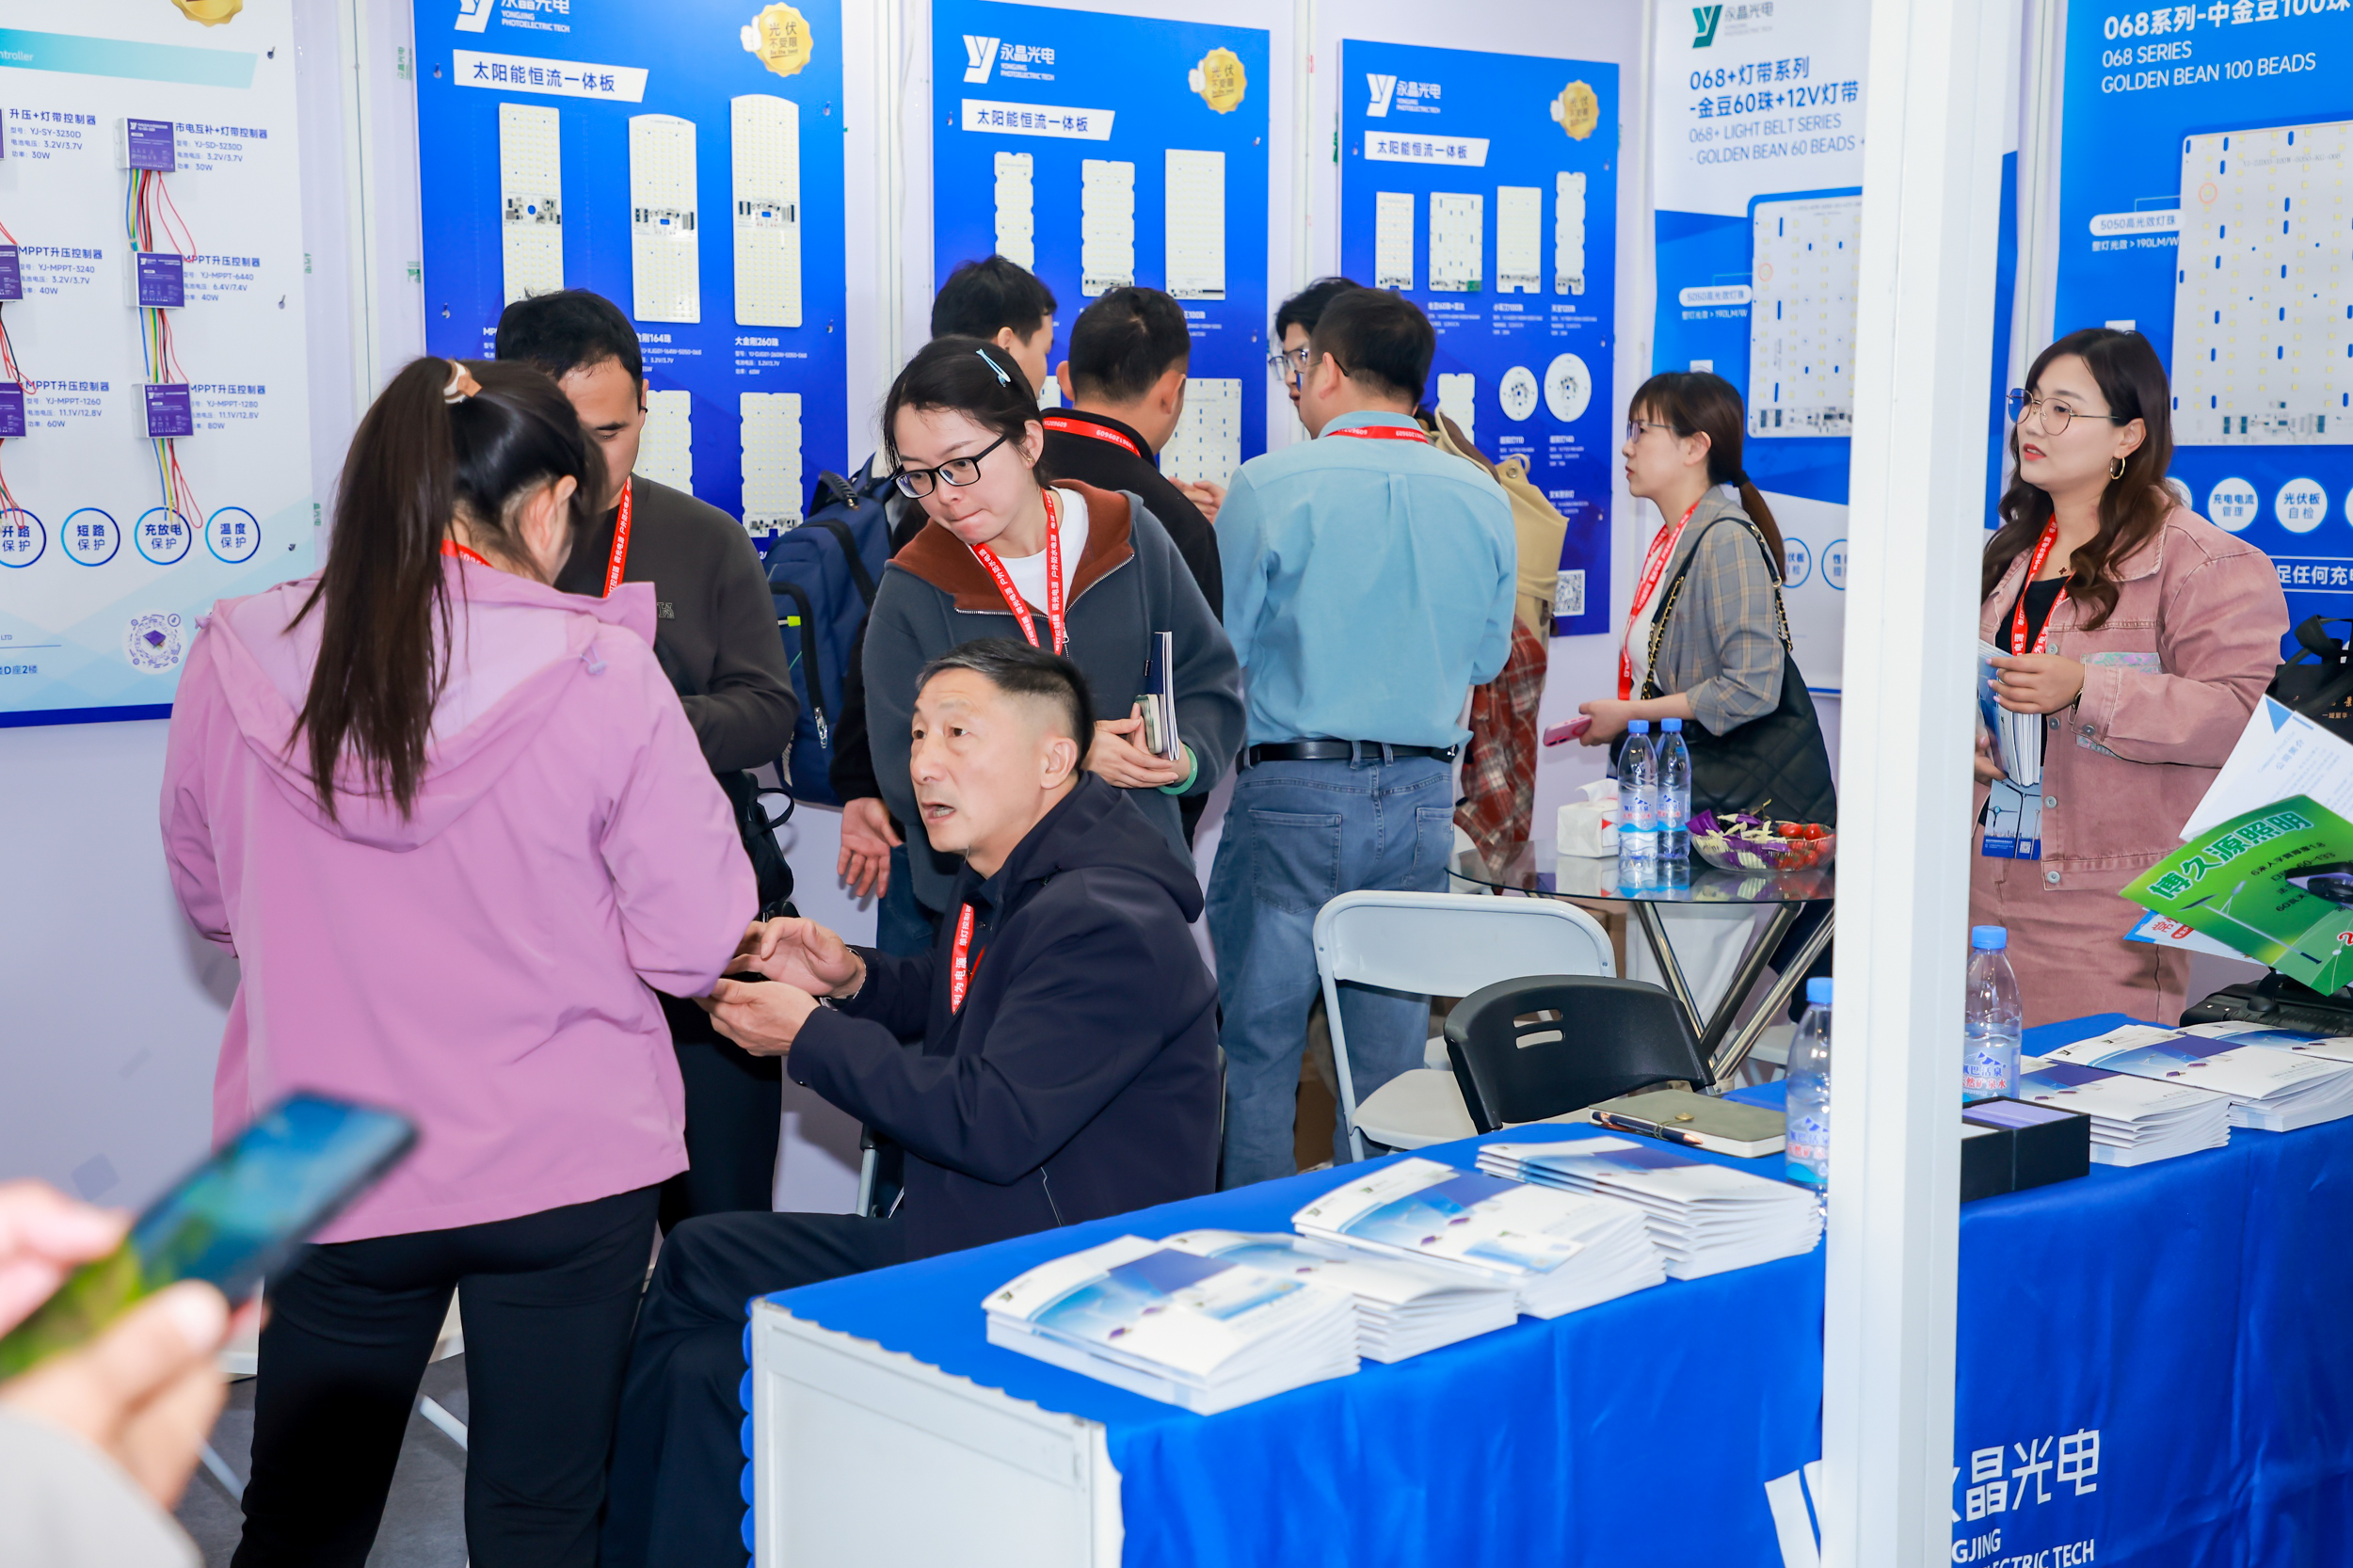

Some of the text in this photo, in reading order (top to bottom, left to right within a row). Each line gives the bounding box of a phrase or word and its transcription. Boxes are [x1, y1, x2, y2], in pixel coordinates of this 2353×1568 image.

[1724, 1, 1773, 22] 永晶光电
[769, 22, 797, 37] 光伏
[1000, 43, 1055, 65] 永晶光电
[2102, 40, 2192, 68] 068 SERIES
[473, 61, 615, 92] 太阳能恒流一体板
[1690, 56, 1810, 90] 068+灯带系列
[2101, 53, 2316, 93] GOLDEN BEAN 100 BEADS
[1397, 80, 1441, 99] 永晶光电
[9, 108, 96, 125] 升压+灯带控制器
[978, 109, 1088, 132] 太阳能恒流一体板
[1724, 121, 1760, 140] LIGHT
[1764, 118, 1794, 136] BELT
[1798, 113, 1842, 132] SERIES
[31, 151, 51, 159] 30W
[1377, 139, 1467, 159] 太阳能恒流一体板
[1697, 147, 1750, 165] GOLDEN
[1753, 142, 1787, 160] BEAN
[1791, 140, 1807, 156] 60
[1811, 135, 1856, 154] BEADS
[2101, 215, 2176, 231] 5050高光效灯珠
[18, 246, 103, 260] MPPT升压控制器
[39, 264, 95, 273] YJ-MPPT-3240
[25, 380, 110, 392] MPPT升压控制器
[45, 397, 102, 407] YJ-MPPT-1260
[2213, 493, 2254, 504] 充电电流
[2284, 492, 2320, 504] 光伏板
[2222, 506, 2244, 517] 管理
[2289, 507, 2314, 520] 自检
[77, 524, 105, 537] 短路
[145, 524, 183, 536] 充放电
[220, 522, 246, 535] 温度
[2, 539, 31, 552] 保护
[78, 539, 105, 551] 保护
[151, 538, 178, 550] 保护
[220, 537, 247, 548] 保护
[1050, 534, 1059, 578] 户外防水电源
[2278, 565, 2353, 585] 足任何充
[1051, 582, 1060, 611] 调光电源
[2147, 810, 2314, 901] 博久源照明
[952, 957, 968, 1012] 利为电源
[1951, 1528, 2001, 1563] GJING
[2053, 1539, 2095, 1568] TECH
